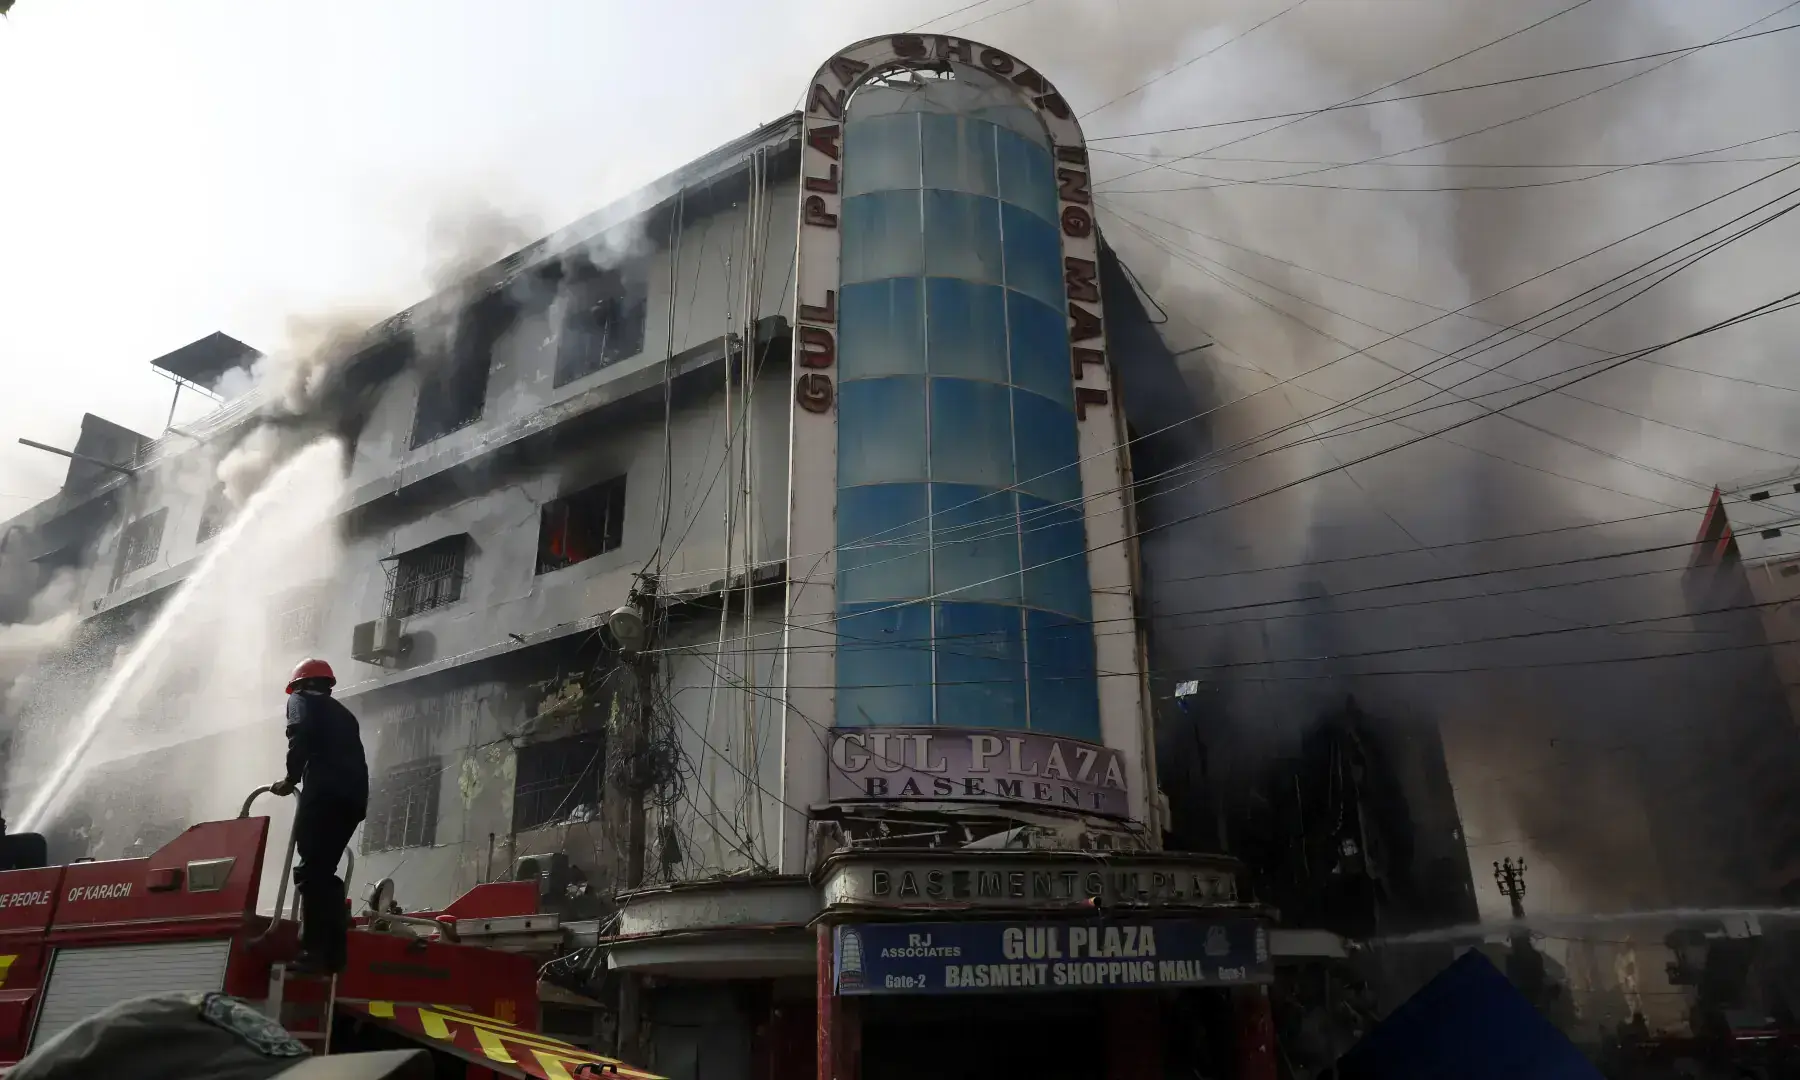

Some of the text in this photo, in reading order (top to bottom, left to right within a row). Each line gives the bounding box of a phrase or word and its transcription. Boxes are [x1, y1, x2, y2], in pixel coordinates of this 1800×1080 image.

[805, 55, 869, 229] PLAZA
[798, 289, 835, 414] GUL
[1065, 256, 1108, 421] MALL
[831, 733, 1126, 790] GUL PLAZA
[864, 777, 1106, 809] BASEMENT
[9, 890, 51, 908] PEOPLE
[68, 887, 85, 902] OF
[83, 883, 133, 900] KARACHI
[881, 947, 961, 958] ASSOCIATES
[908, 934, 933, 947] RJ
[1003, 926, 1157, 960] GUL PLAZA
[885, 974, 926, 989] Gate-2
[945, 960, 1206, 988] BASMENT SHOPPING MALL
